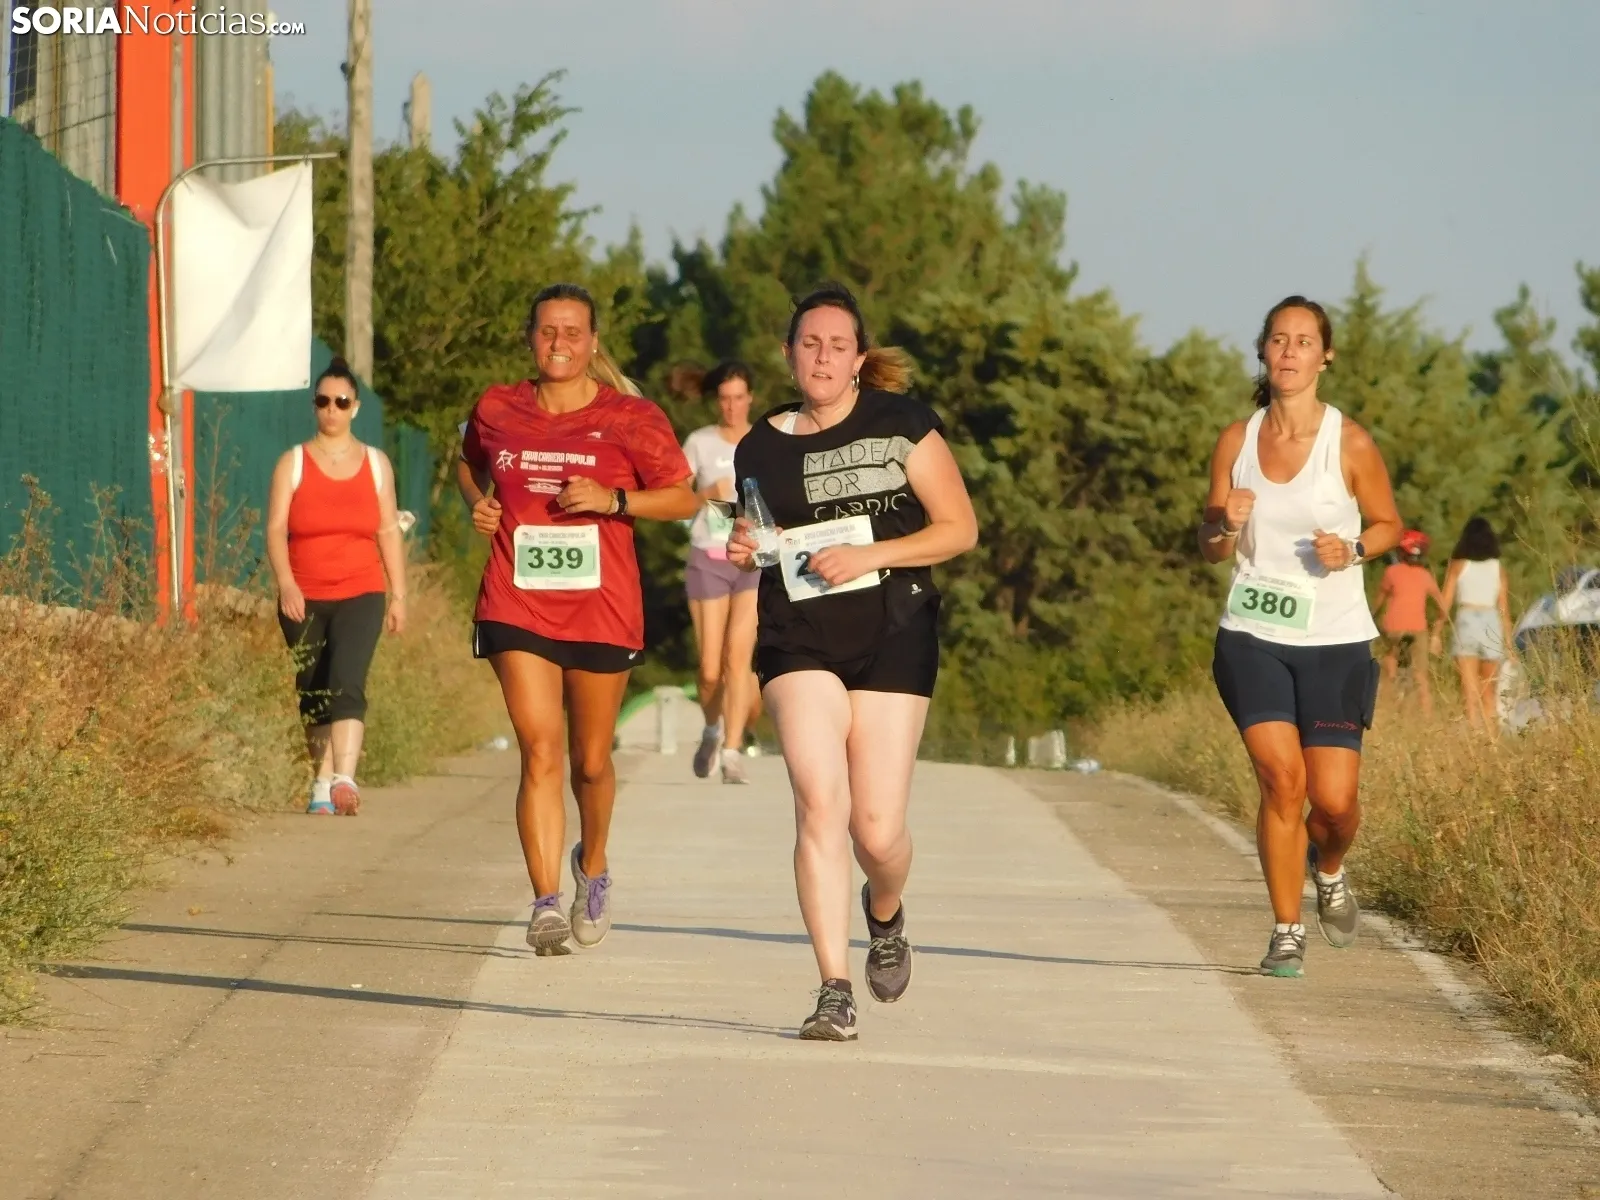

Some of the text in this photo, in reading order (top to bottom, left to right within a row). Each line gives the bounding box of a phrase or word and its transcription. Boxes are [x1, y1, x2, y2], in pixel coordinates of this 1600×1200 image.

[566, 452, 596, 467] POPULAR
[806, 441, 883, 472] MADE
[807, 472, 862, 501] FOR
[528, 546, 583, 569] 339
[1241, 587, 1297, 618] 380
